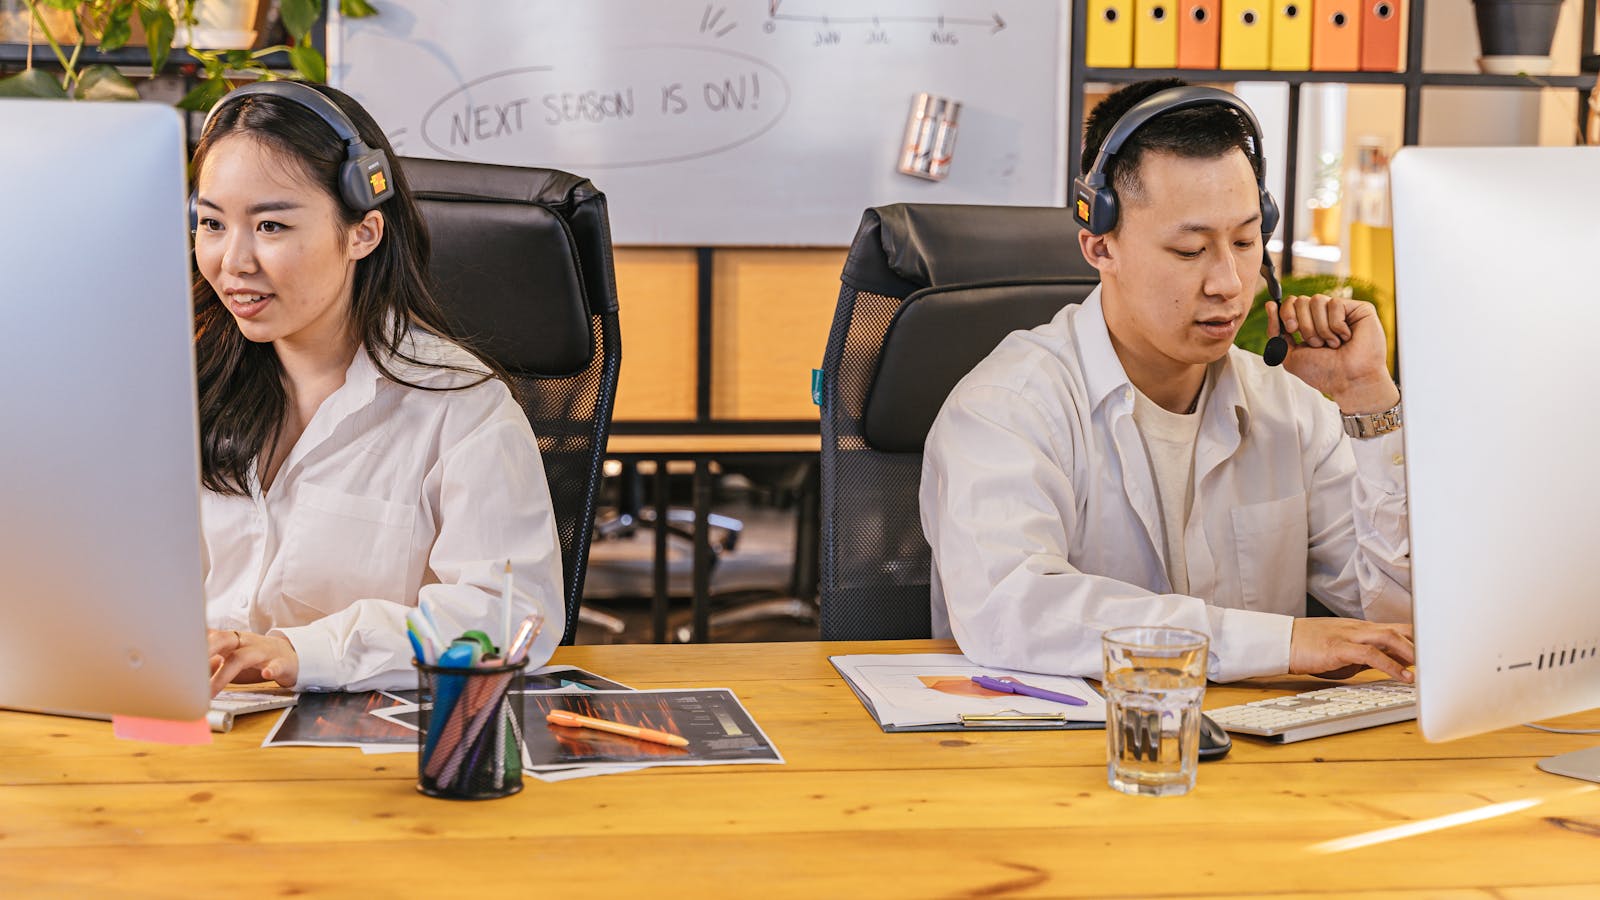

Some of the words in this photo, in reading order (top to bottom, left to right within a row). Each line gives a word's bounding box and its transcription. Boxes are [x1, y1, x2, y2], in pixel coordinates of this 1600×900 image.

[450, 97, 529, 145] NEXT
[542, 86, 634, 126] SEASON
[661, 82, 689, 115] IS
[703, 71, 760, 112] ON!
